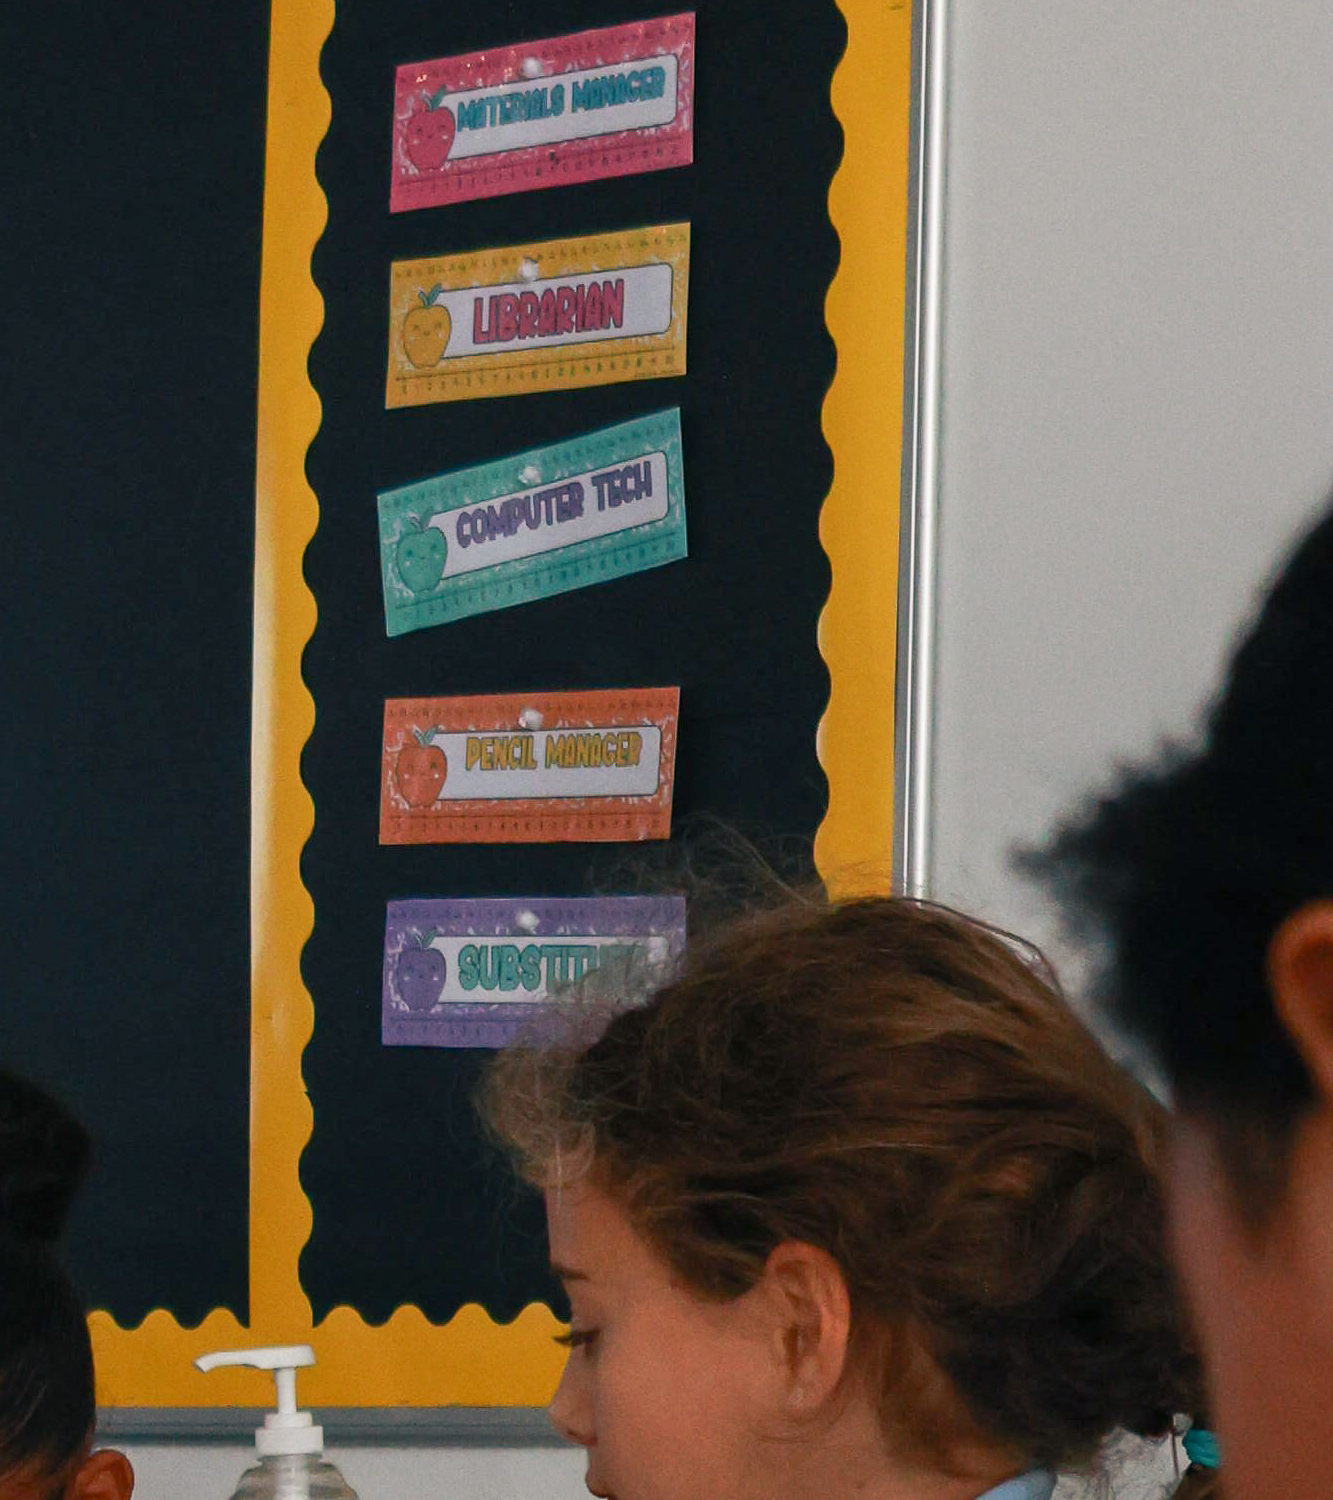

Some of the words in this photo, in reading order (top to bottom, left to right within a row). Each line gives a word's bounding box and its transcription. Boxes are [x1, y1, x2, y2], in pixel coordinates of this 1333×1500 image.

[456, 83, 565, 133] MATERIALS
[571, 66, 666, 113] MANAGER
[473, 278, 625, 345] LIBRARIAN
[456, 481, 585, 549] COMPUTER
[590, 460, 653, 512] TECH
[465, 734, 537, 771] PENCIL
[545, 731, 643, 769] MANAGER
[458, 943, 648, 991] SUBSTITU
